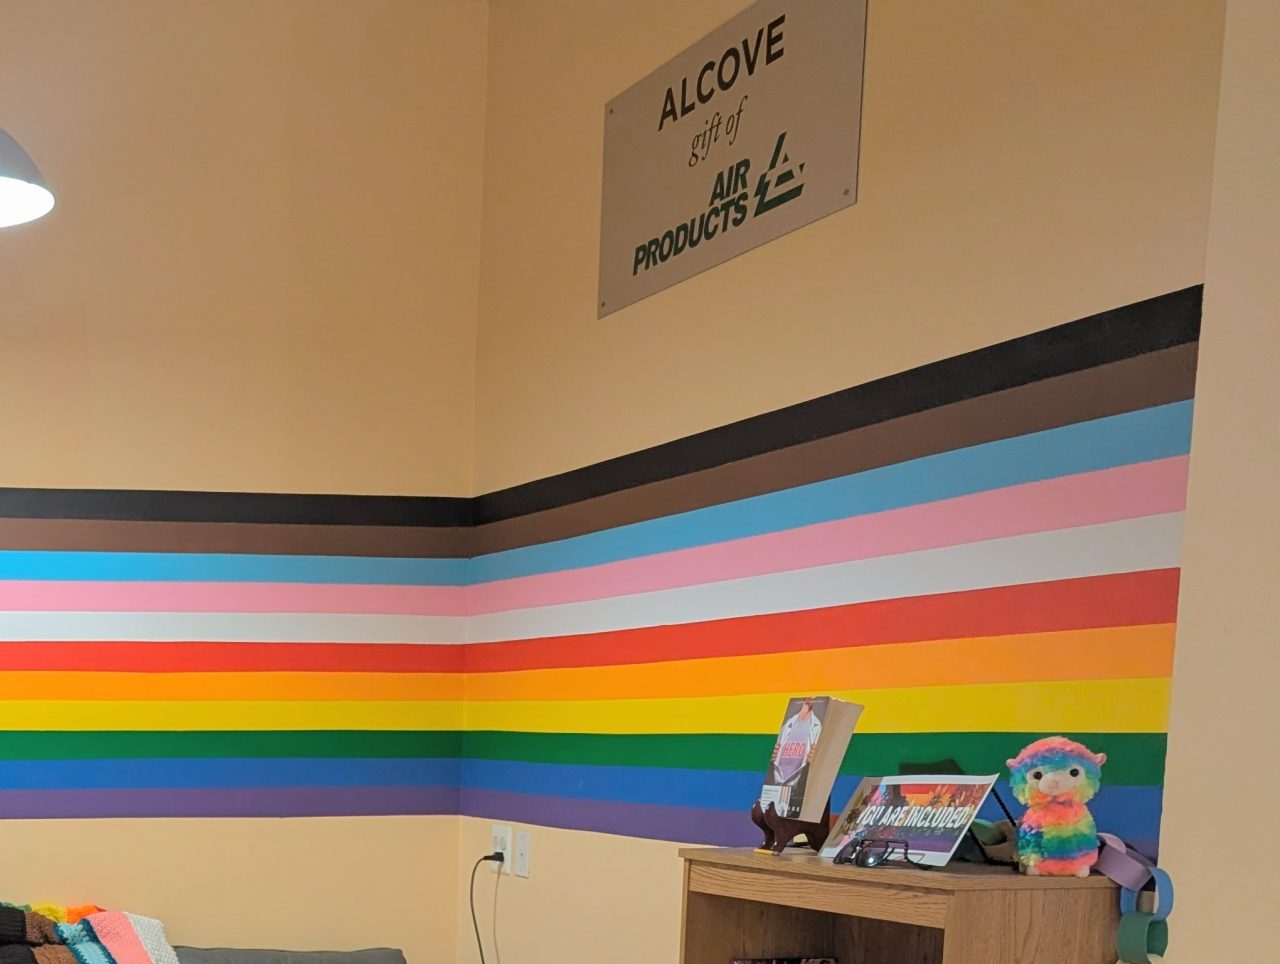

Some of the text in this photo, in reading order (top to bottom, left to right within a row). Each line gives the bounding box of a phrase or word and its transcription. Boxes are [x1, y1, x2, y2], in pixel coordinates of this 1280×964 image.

[658, 14, 786, 131] ALCOVE
[688, 95, 748, 167] gift of
[709, 158, 751, 207] AIR
[632, 191, 748, 276] PRODUCTS
[878, 805, 910, 827] ARE
